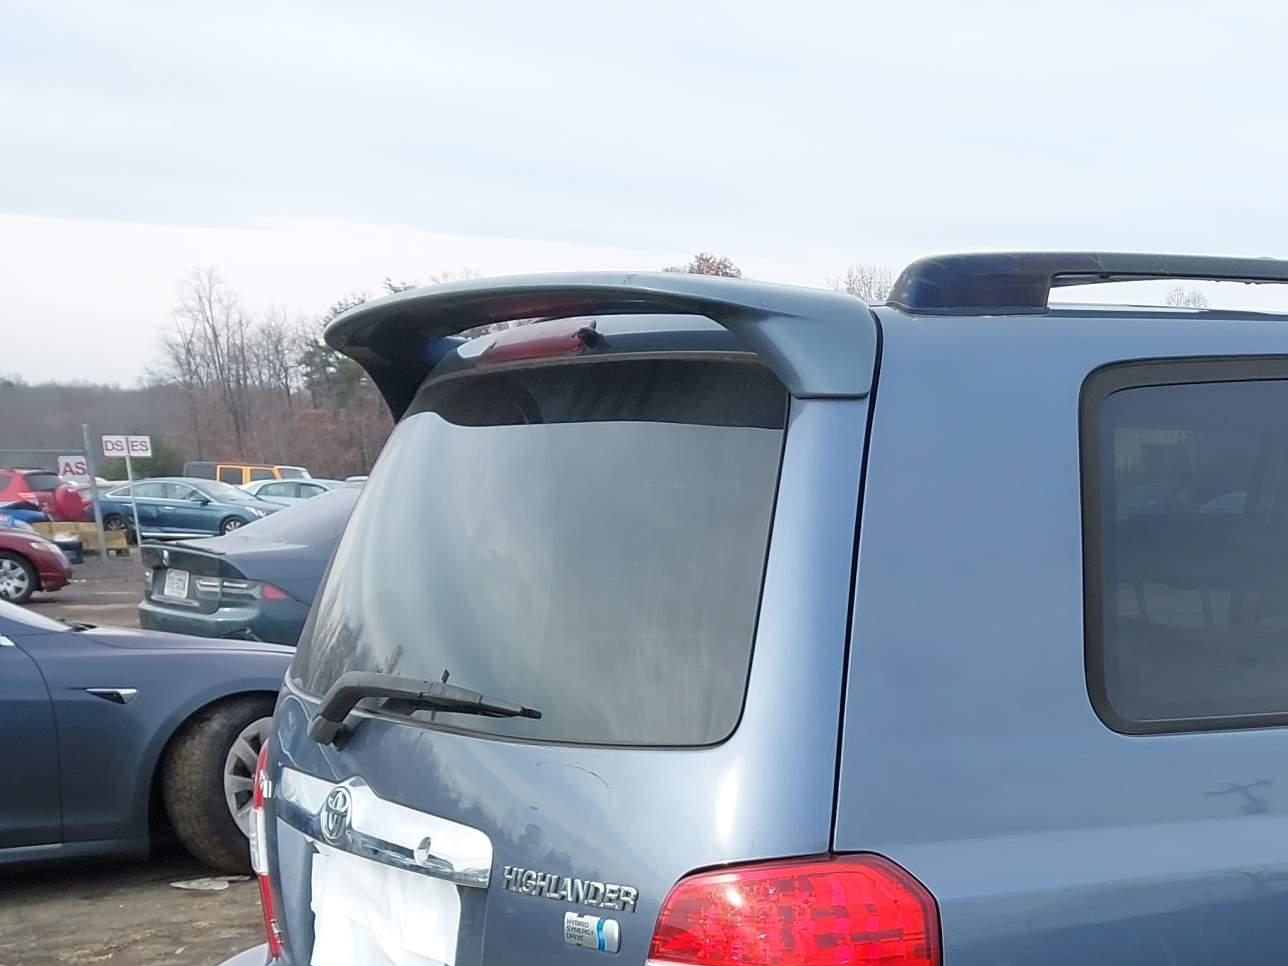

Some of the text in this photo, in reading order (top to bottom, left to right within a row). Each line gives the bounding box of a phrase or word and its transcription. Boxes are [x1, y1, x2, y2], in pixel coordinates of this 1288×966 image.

[104, 440, 124, 451] DS
[130, 441, 149, 451] ES
[62, 462, 86, 475] AS
[503, 865, 639, 913] HIGHLANDER
[566, 918, 590, 928] HYBRID
[566, 925, 595, 936] SYNERGY
[566, 933, 585, 942] DRIVE
